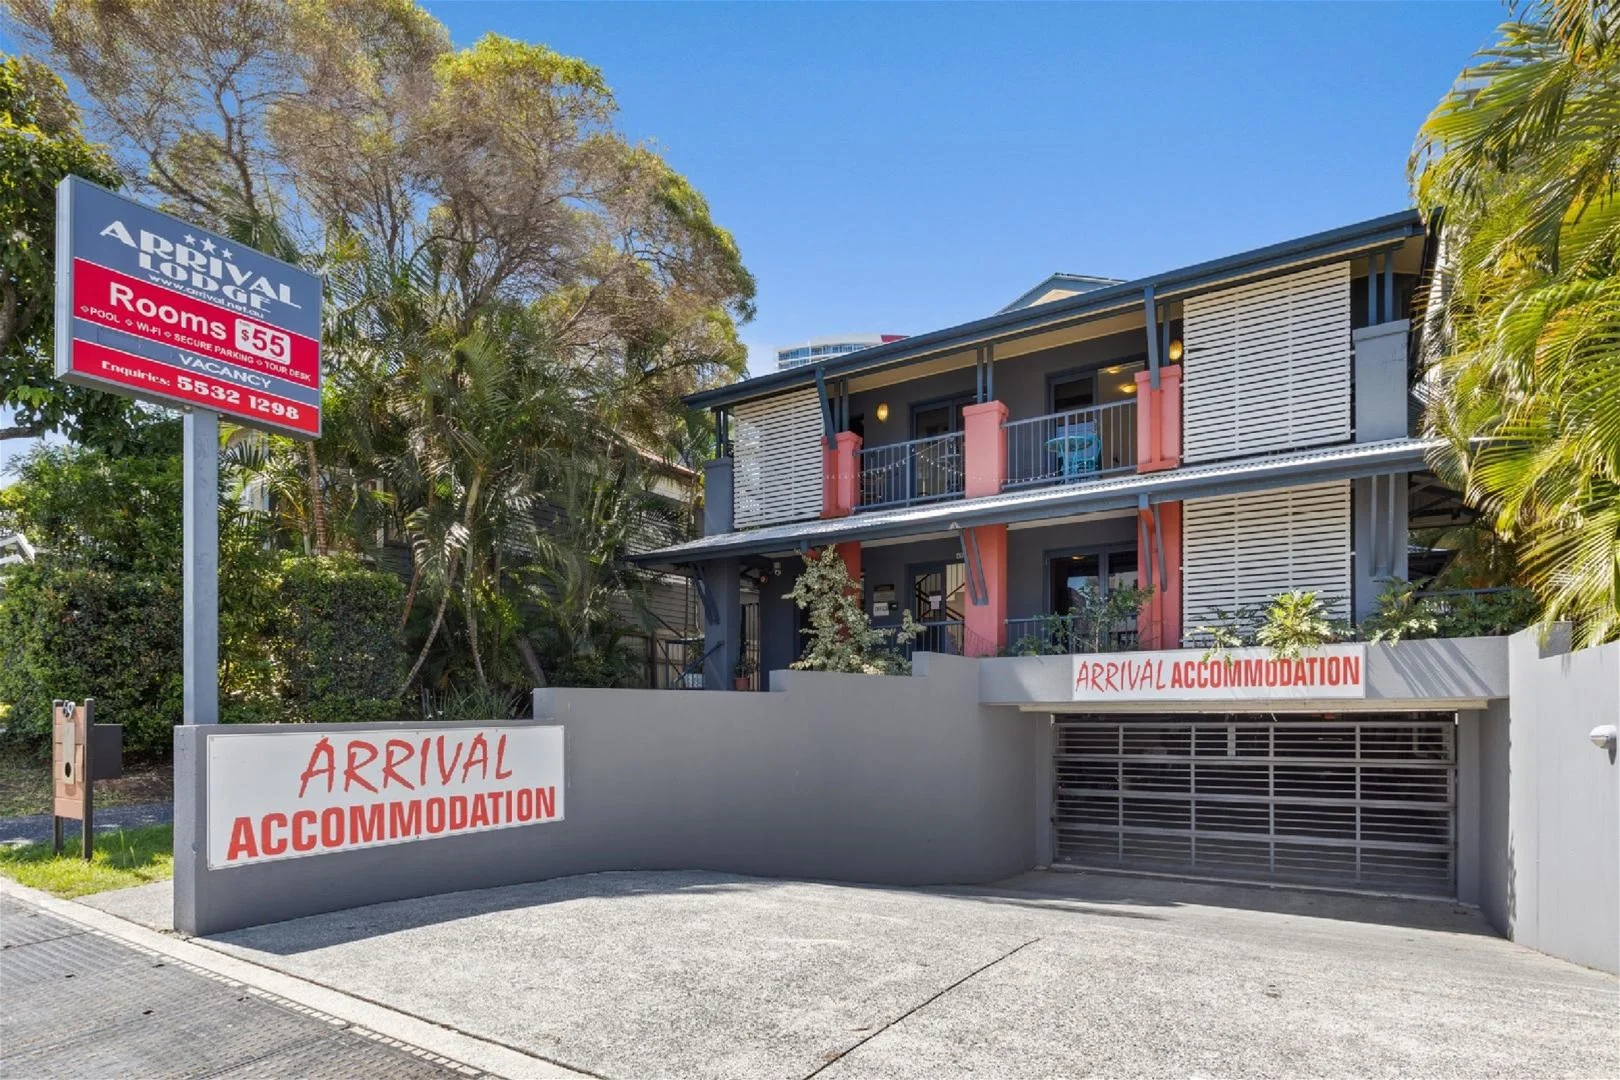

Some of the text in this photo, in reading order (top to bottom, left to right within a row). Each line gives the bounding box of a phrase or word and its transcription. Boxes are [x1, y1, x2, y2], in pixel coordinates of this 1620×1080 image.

[100, 220, 302, 309] ARRIVAL
[139, 251, 272, 313] LODGE
[147, 273, 264, 319] www.arrival.net.au
[90, 306, 121, 324] POOL
[173, 333, 213, 352] SECURE
[214, 346, 254, 365] PARKING
[264, 360, 289, 376] TOUR
[289, 369, 311, 383] DESK
[110, 281, 285, 358] Rooms $55
[101, 360, 300, 421] Enquiries: 5532 1298
[178, 353, 272, 389] VACANCY
[1075, 655, 1360, 692] ARRIVAL ACCOMMODATION
[299, 731, 513, 799] ARRIVAL
[226, 786, 557, 861] ACCOMMODATION
